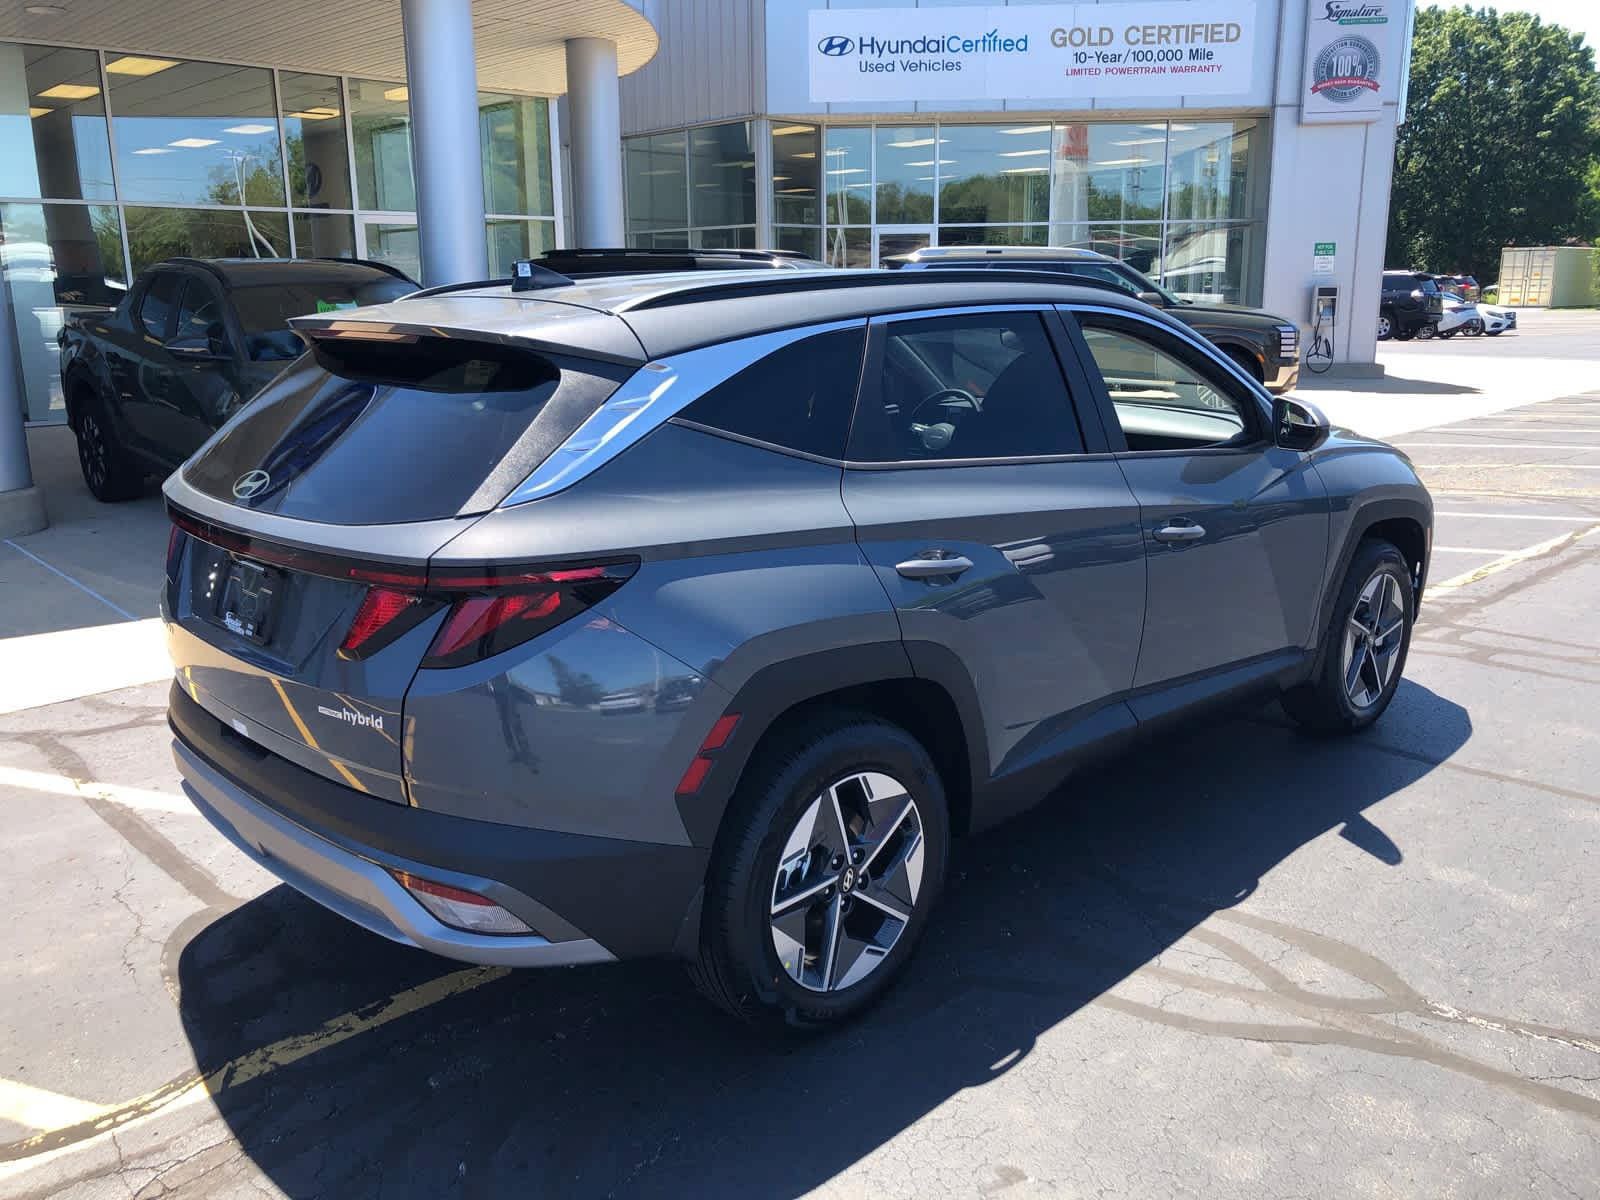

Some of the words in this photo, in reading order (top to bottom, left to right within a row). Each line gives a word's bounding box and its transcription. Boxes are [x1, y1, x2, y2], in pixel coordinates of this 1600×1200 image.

[1315, 0, 1384, 22] Signature
[1050, 27, 1114, 48] GOLD
[1124, 23, 1241, 46] CERTIFIED
[859, 60, 895, 73] Used
[899, 59, 962, 73] Vehicles
[1073, 49, 1183, 64] 10-Year/100,000
[1189, 48, 1214, 61] Mile
[1332, 55, 1363, 78] 100%
[1065, 67, 1102, 77] LIMITED
[1104, 66, 1166, 76] POWERTRAIN
[1170, 64, 1223, 74] WARRANTY
[342, 707, 383, 729] hybrid
